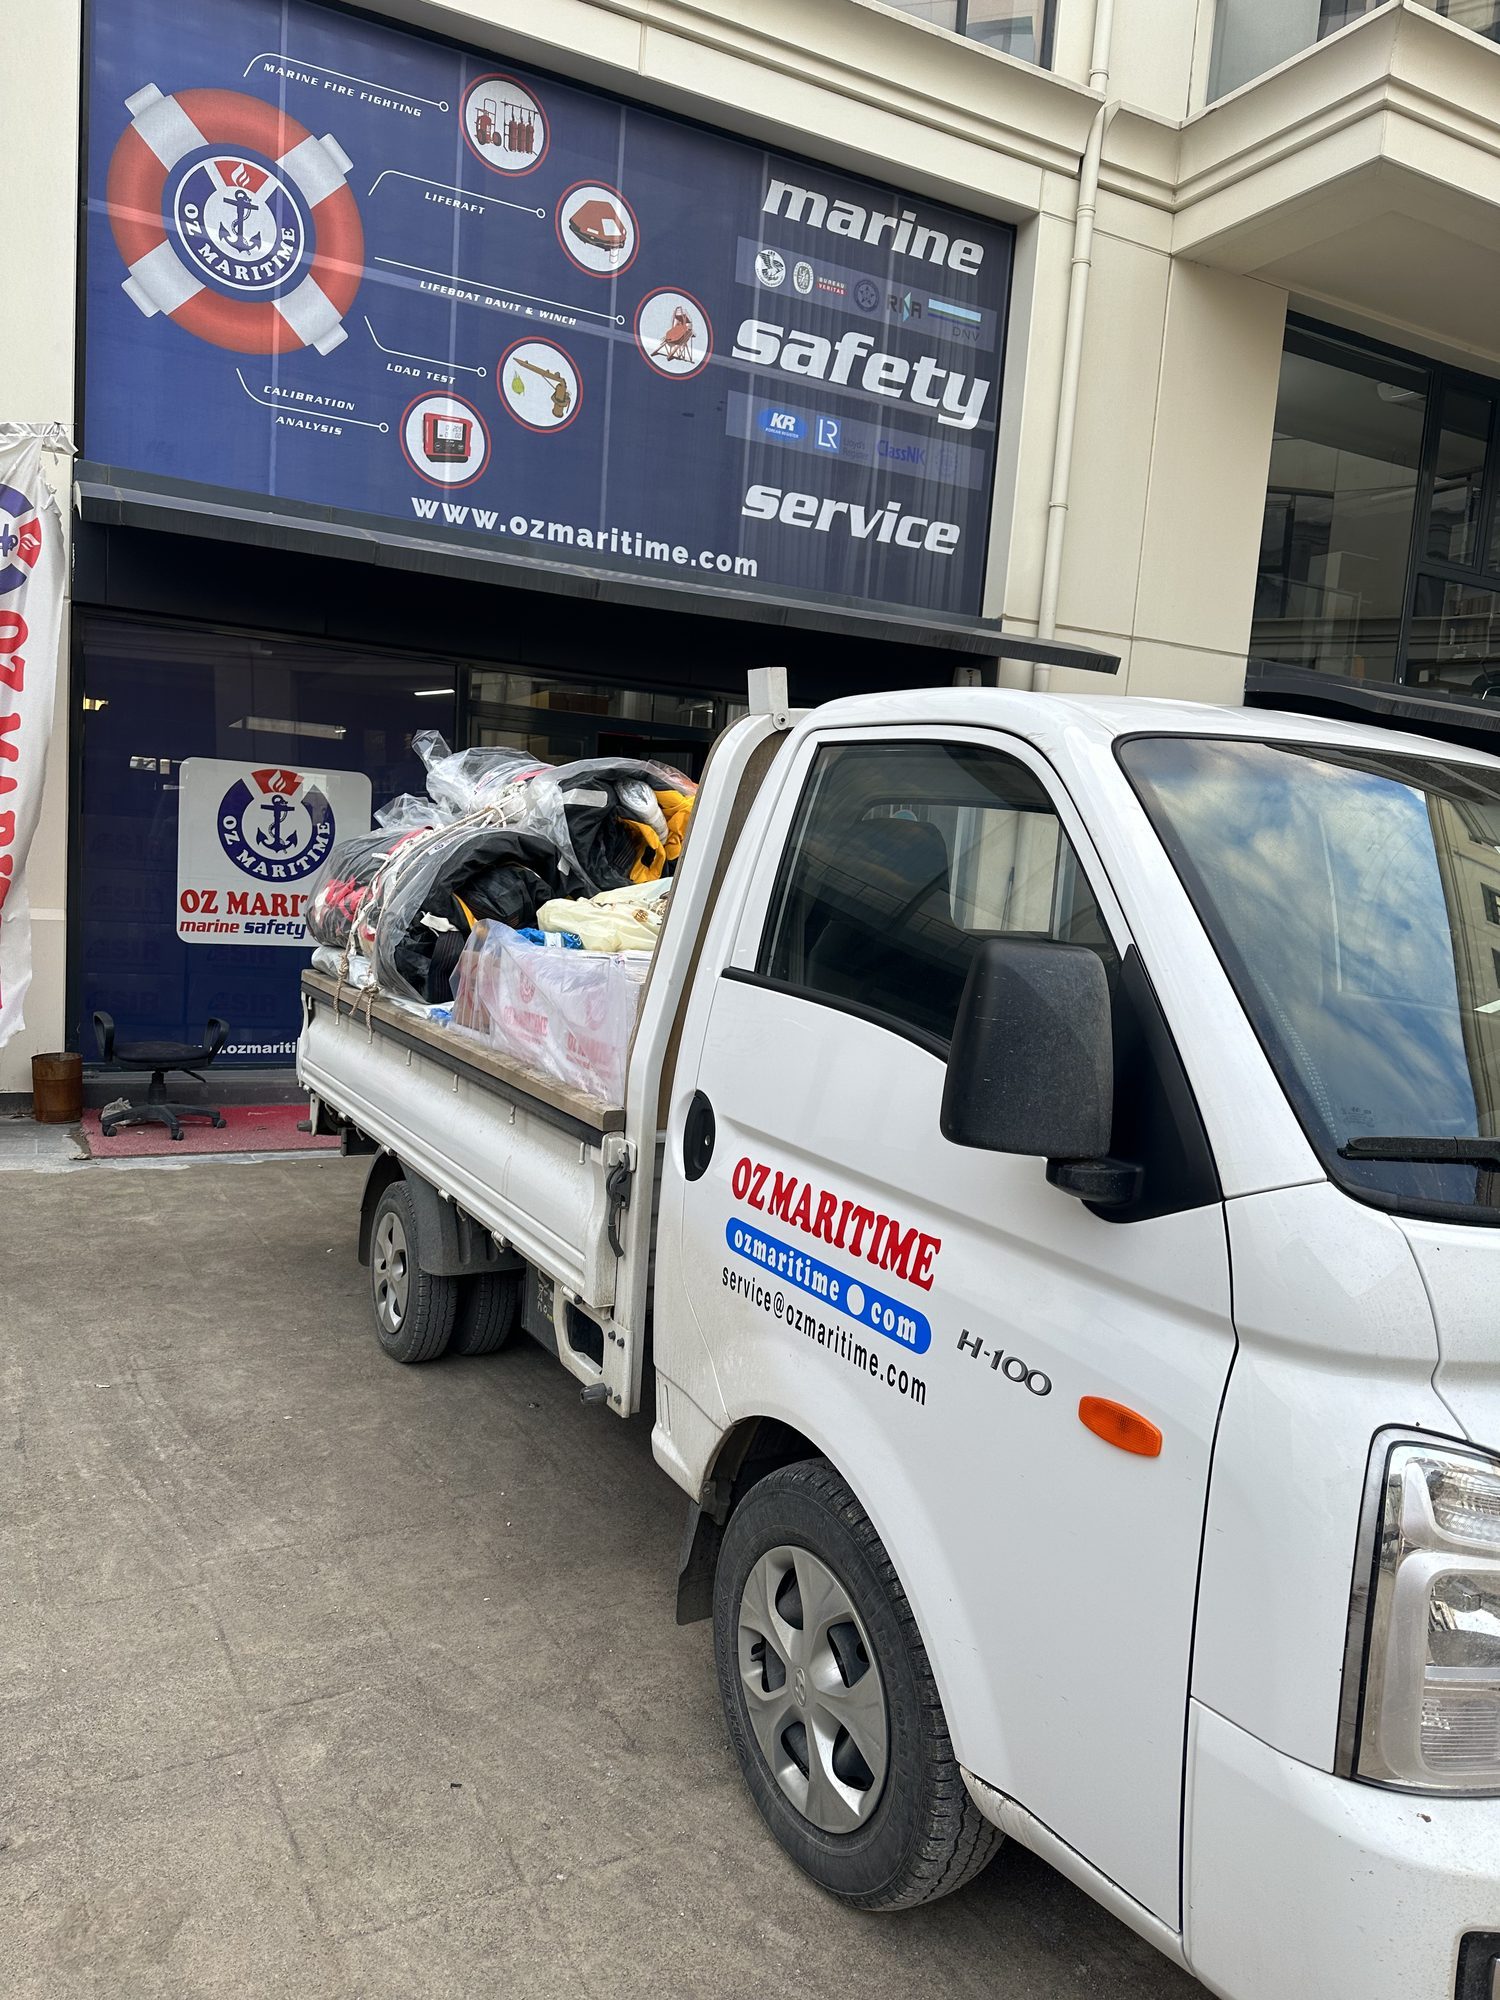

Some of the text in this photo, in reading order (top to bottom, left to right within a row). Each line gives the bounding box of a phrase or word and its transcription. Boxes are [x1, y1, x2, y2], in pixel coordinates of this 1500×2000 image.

[263, 63, 422, 117] MARINE FIRE FIGHTING
[425, 192, 485, 215] LIFERAFT
[184, 203, 295, 281] OZ MARITIME
[762, 179, 984, 276] marine
[819, 277, 845, 295] BUREAU VERITAS
[420, 281, 577, 326] LIFEBOAT DAVIT & WINCH
[952, 326, 980, 341] DNV
[386, 363, 456, 384] LOAD TEST
[732, 319, 991, 430] safety
[263, 386, 355, 411] CALIBRATION
[275, 416, 343, 436] ANALYSIS
[770, 412, 796, 432] KR
[818, 419, 837, 449] LR
[878, 440, 926, 465] ClassNK
[741, 484, 960, 555] service
[411, 497, 758, 577] www.ozmaritime.com
[223, 815, 330, 878] OZ MARITIME
[180, 889, 219, 914] OZ
[180, 919, 306, 939] marine safety
[722, 1265, 927, 1406] service@ozmaritime.com
[956, 1329, 1053, 1397] H-100
